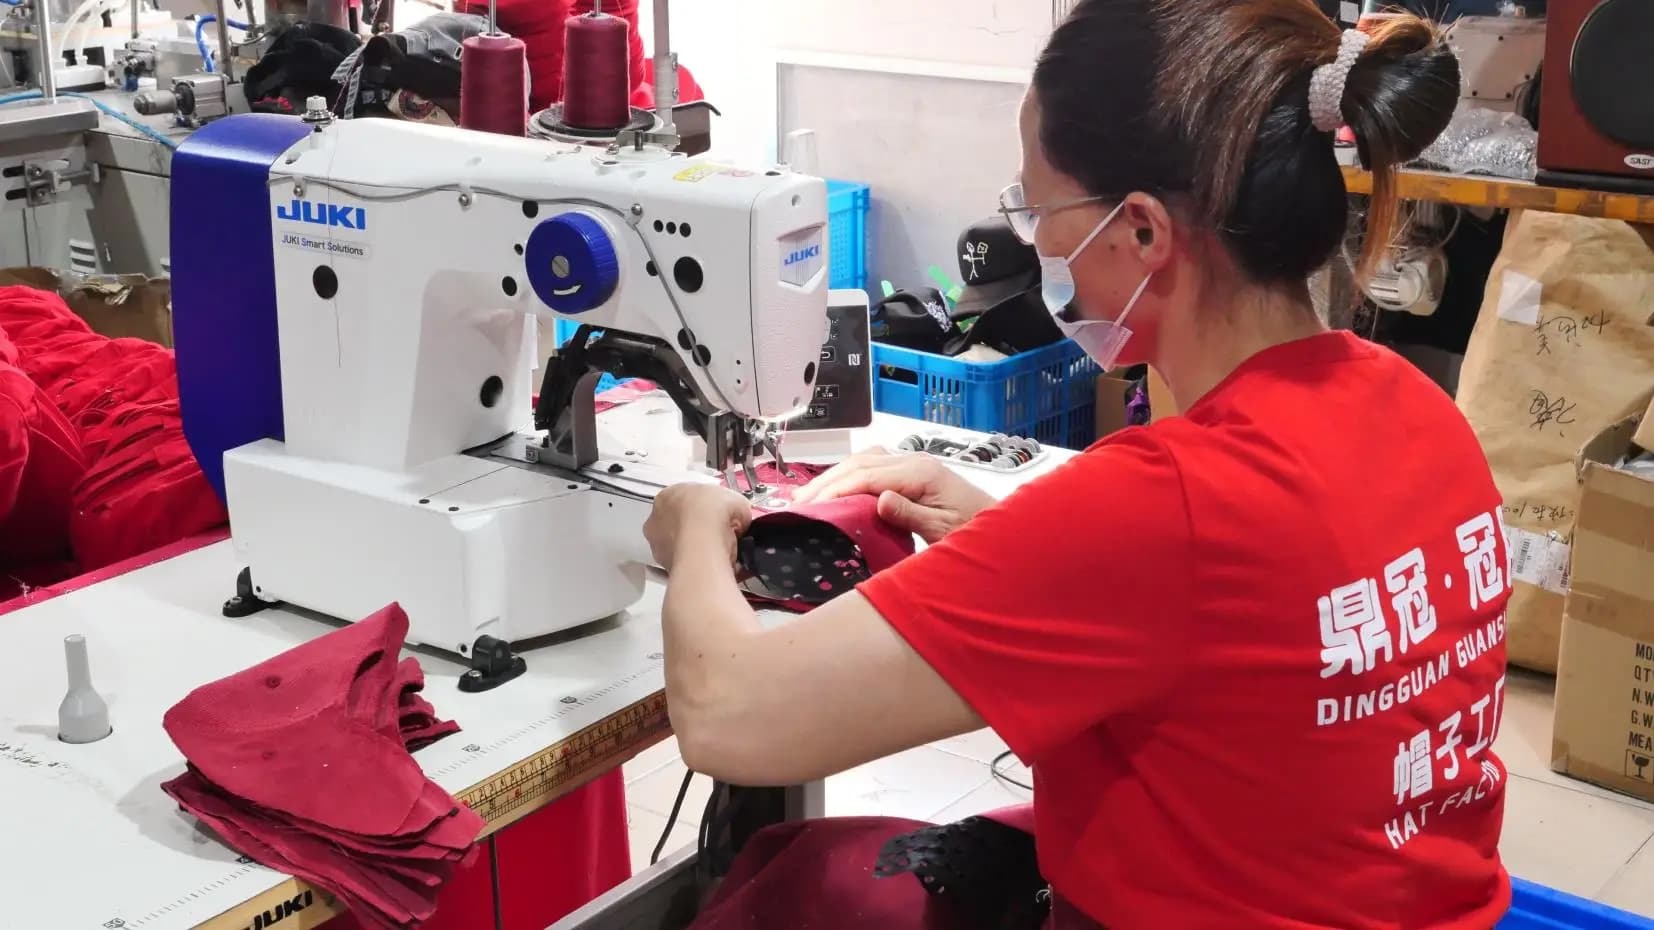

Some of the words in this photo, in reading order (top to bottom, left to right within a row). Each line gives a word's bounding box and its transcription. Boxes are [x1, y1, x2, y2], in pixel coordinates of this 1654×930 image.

[276, 199, 366, 231] JUKI
[282, 232, 300, 246] JUKI
[301, 237, 326, 251] Smart
[327, 241, 364, 256] Solutions
[784, 244, 819, 266] JUKI
[1635, 642, 1654, 661] MO
[1316, 650, 1450, 727] DINGGUAN
[1455, 611, 1506, 669] GUANS
[1634, 664, 1654, 683] QT
[1384, 801, 1434, 850] HAT
[241, 889, 313, 930] JUKI
